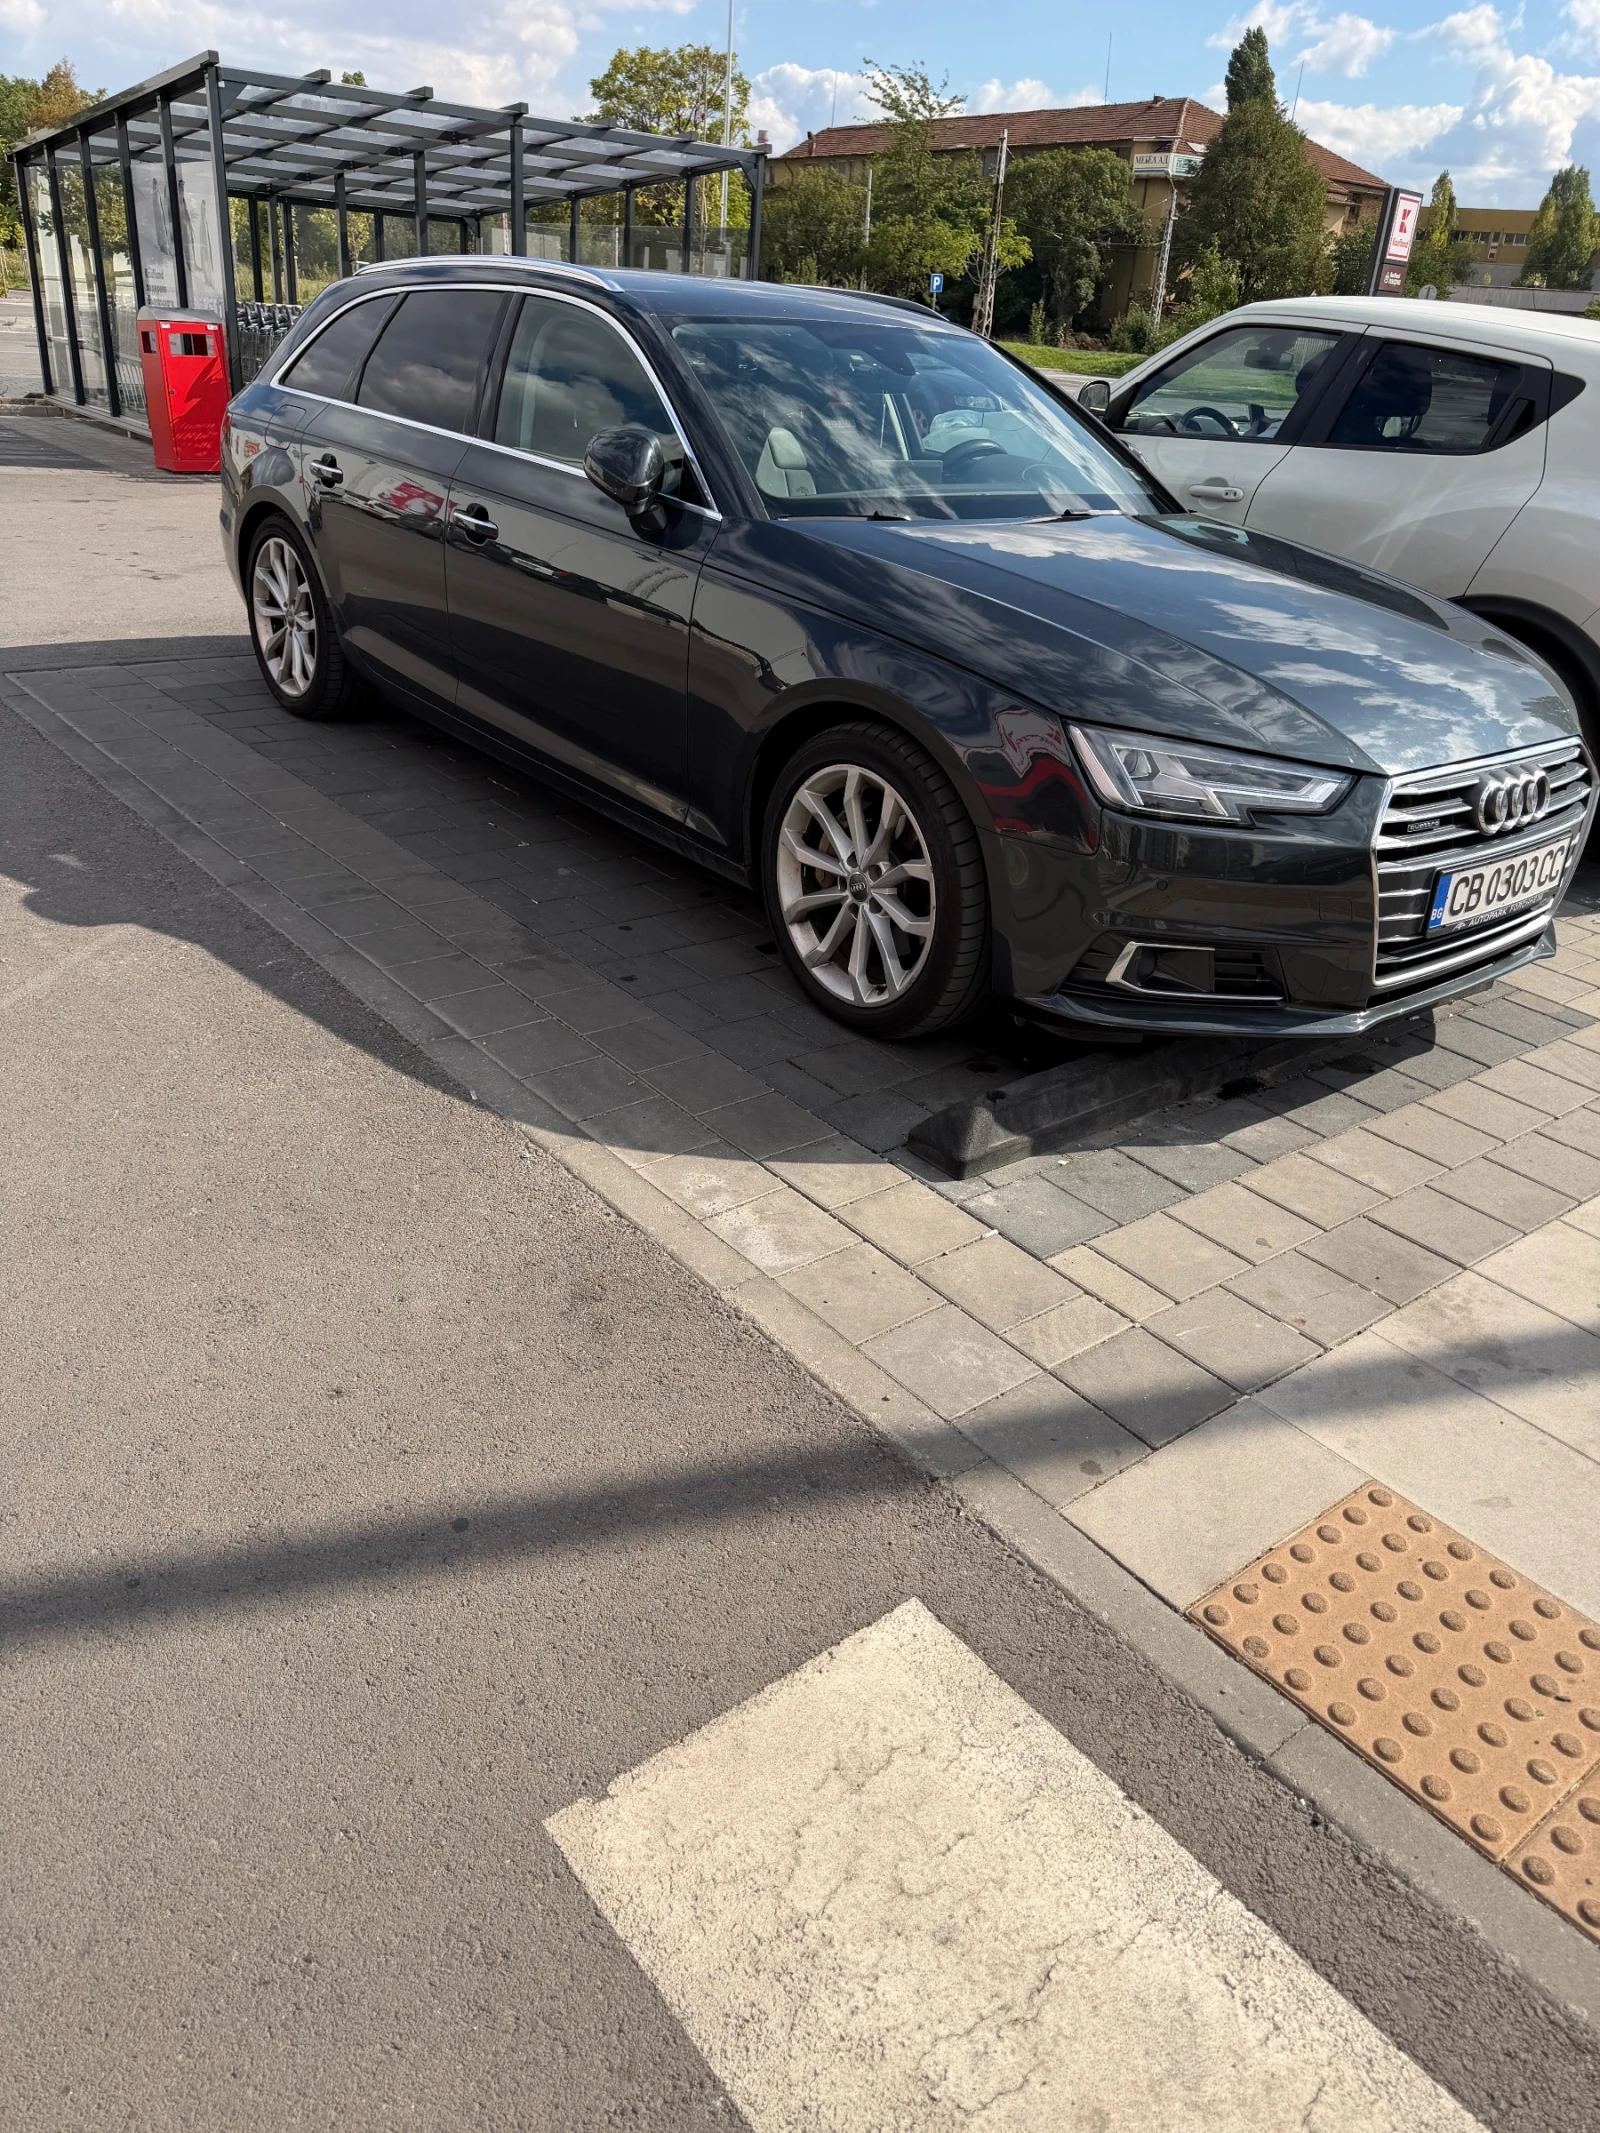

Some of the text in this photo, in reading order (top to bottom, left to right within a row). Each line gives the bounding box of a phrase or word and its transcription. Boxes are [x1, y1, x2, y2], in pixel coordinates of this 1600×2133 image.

[933, 276, 940, 290] P
[1431, 907, 1443, 920] BG
[1468, 909, 1507, 927] AUTOPARK
